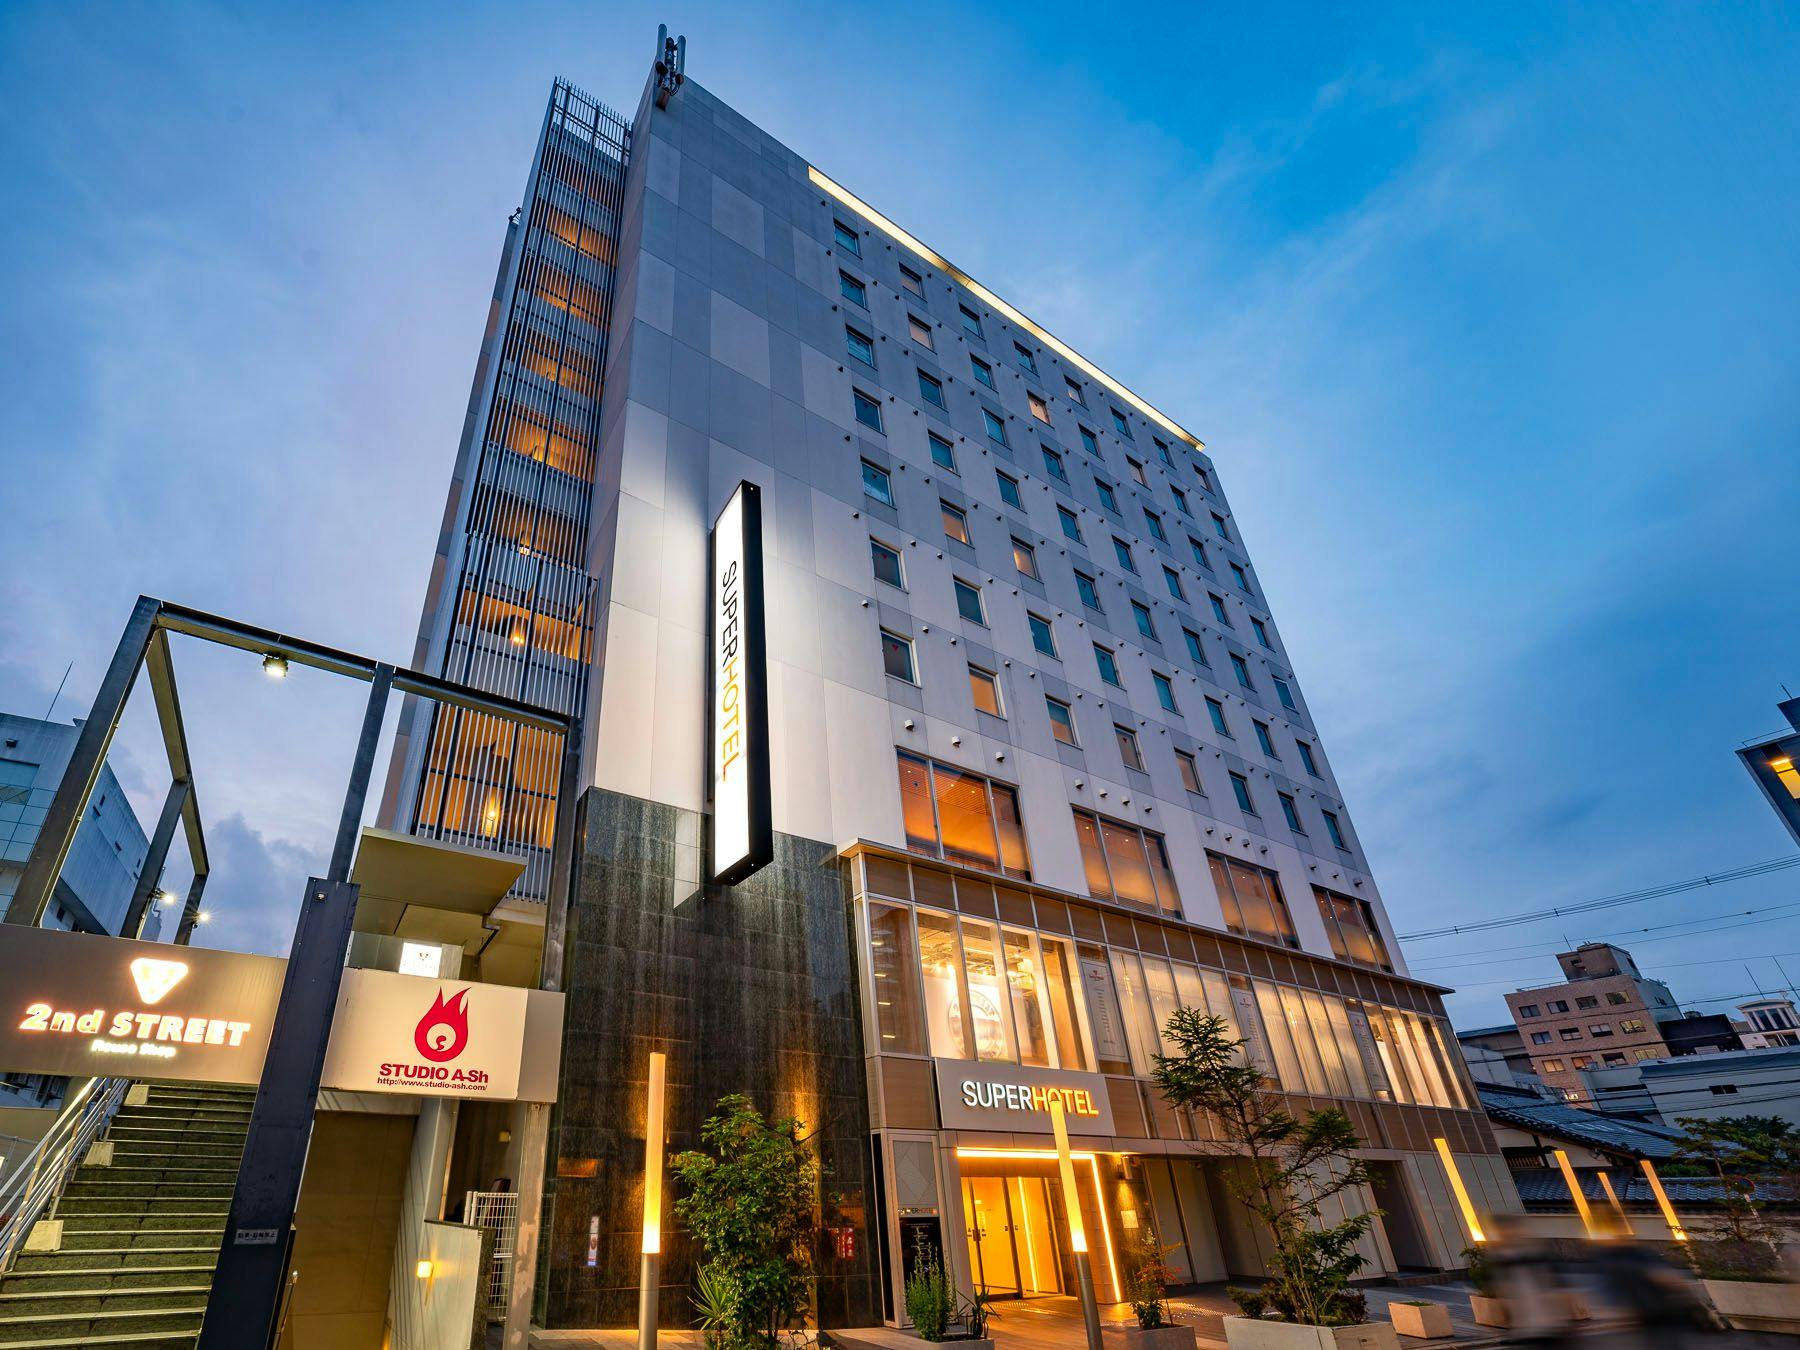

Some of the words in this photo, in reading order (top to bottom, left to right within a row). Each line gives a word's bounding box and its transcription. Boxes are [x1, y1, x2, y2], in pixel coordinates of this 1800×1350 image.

[19, 1003, 105, 1034] 2nd
[109, 1011, 251, 1047] STREET
[379, 1063, 449, 1080] STUDIO
